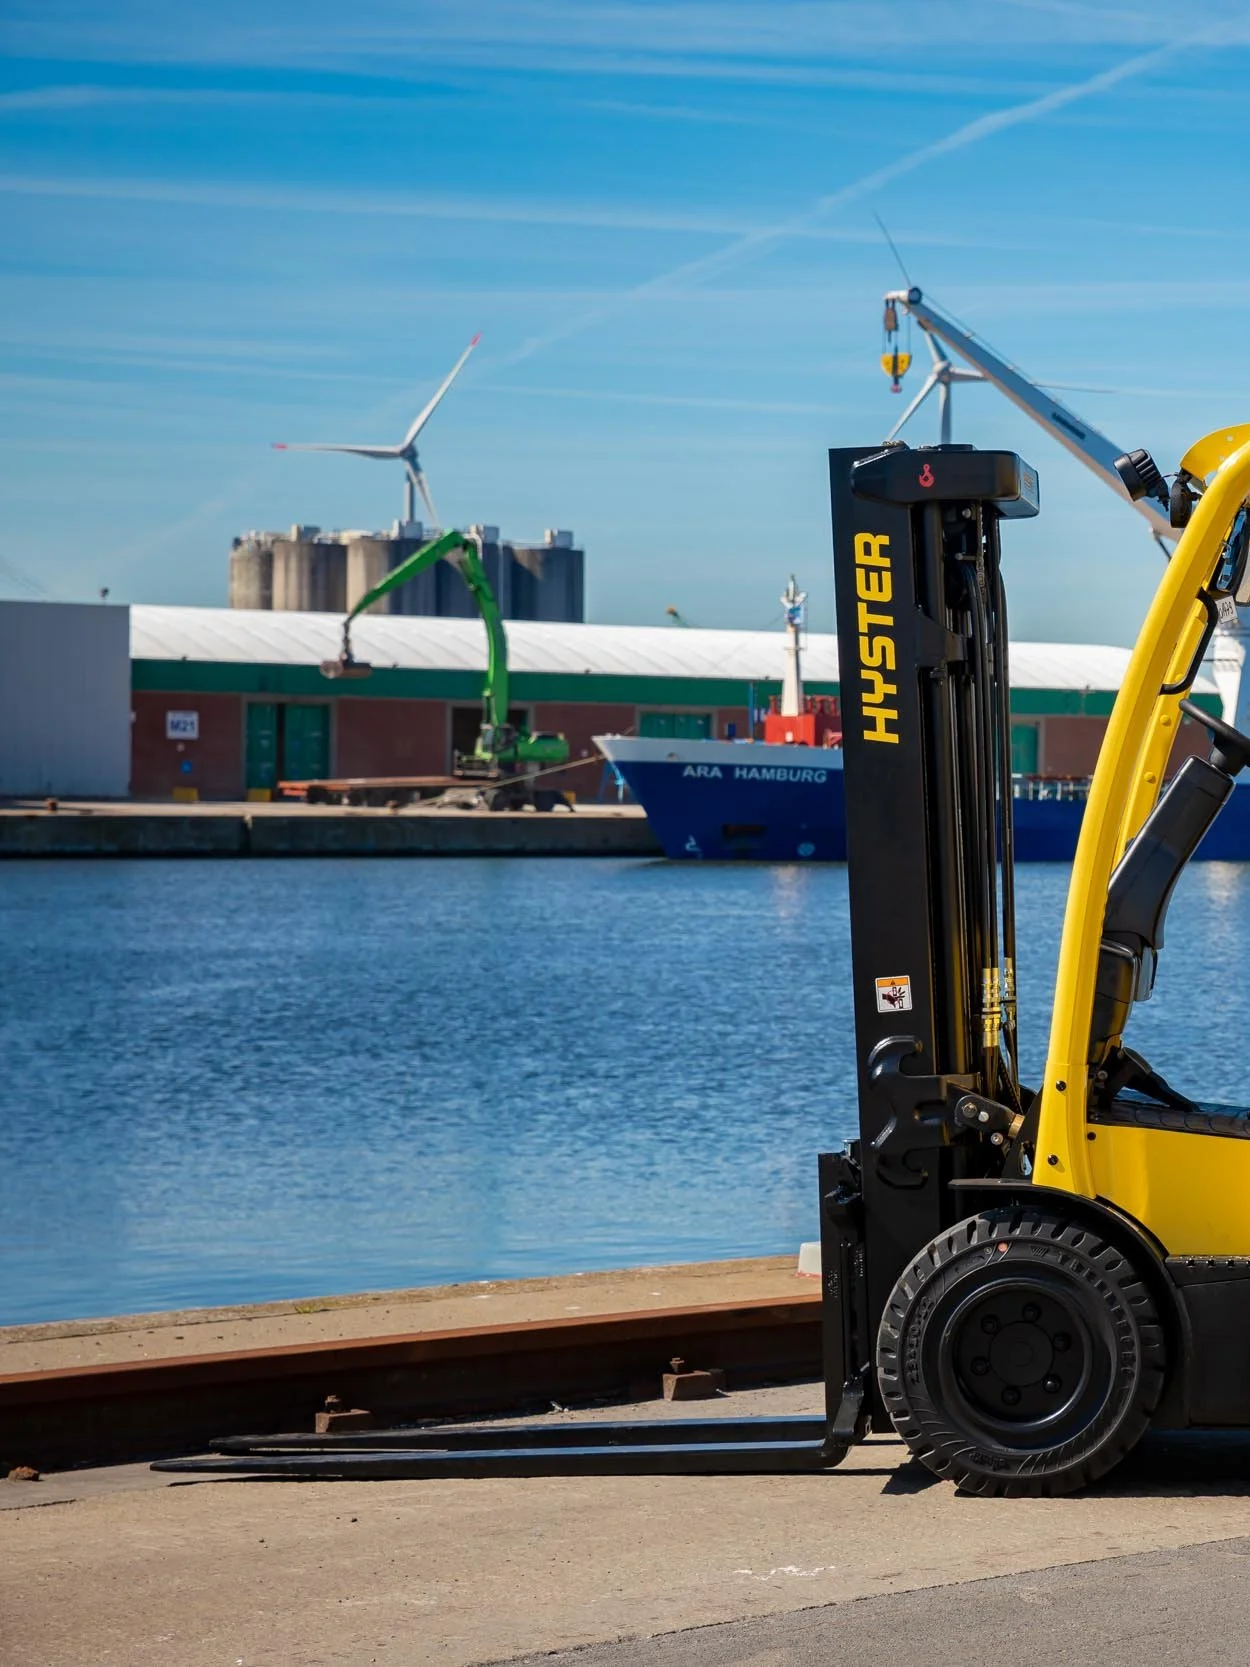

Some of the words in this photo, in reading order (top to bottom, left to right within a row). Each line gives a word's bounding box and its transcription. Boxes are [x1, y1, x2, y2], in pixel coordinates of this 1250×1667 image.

[854, 532, 900, 744] HYSTER
[682, 765, 723, 778] ARA
[734, 766, 828, 783] HAMBURG
